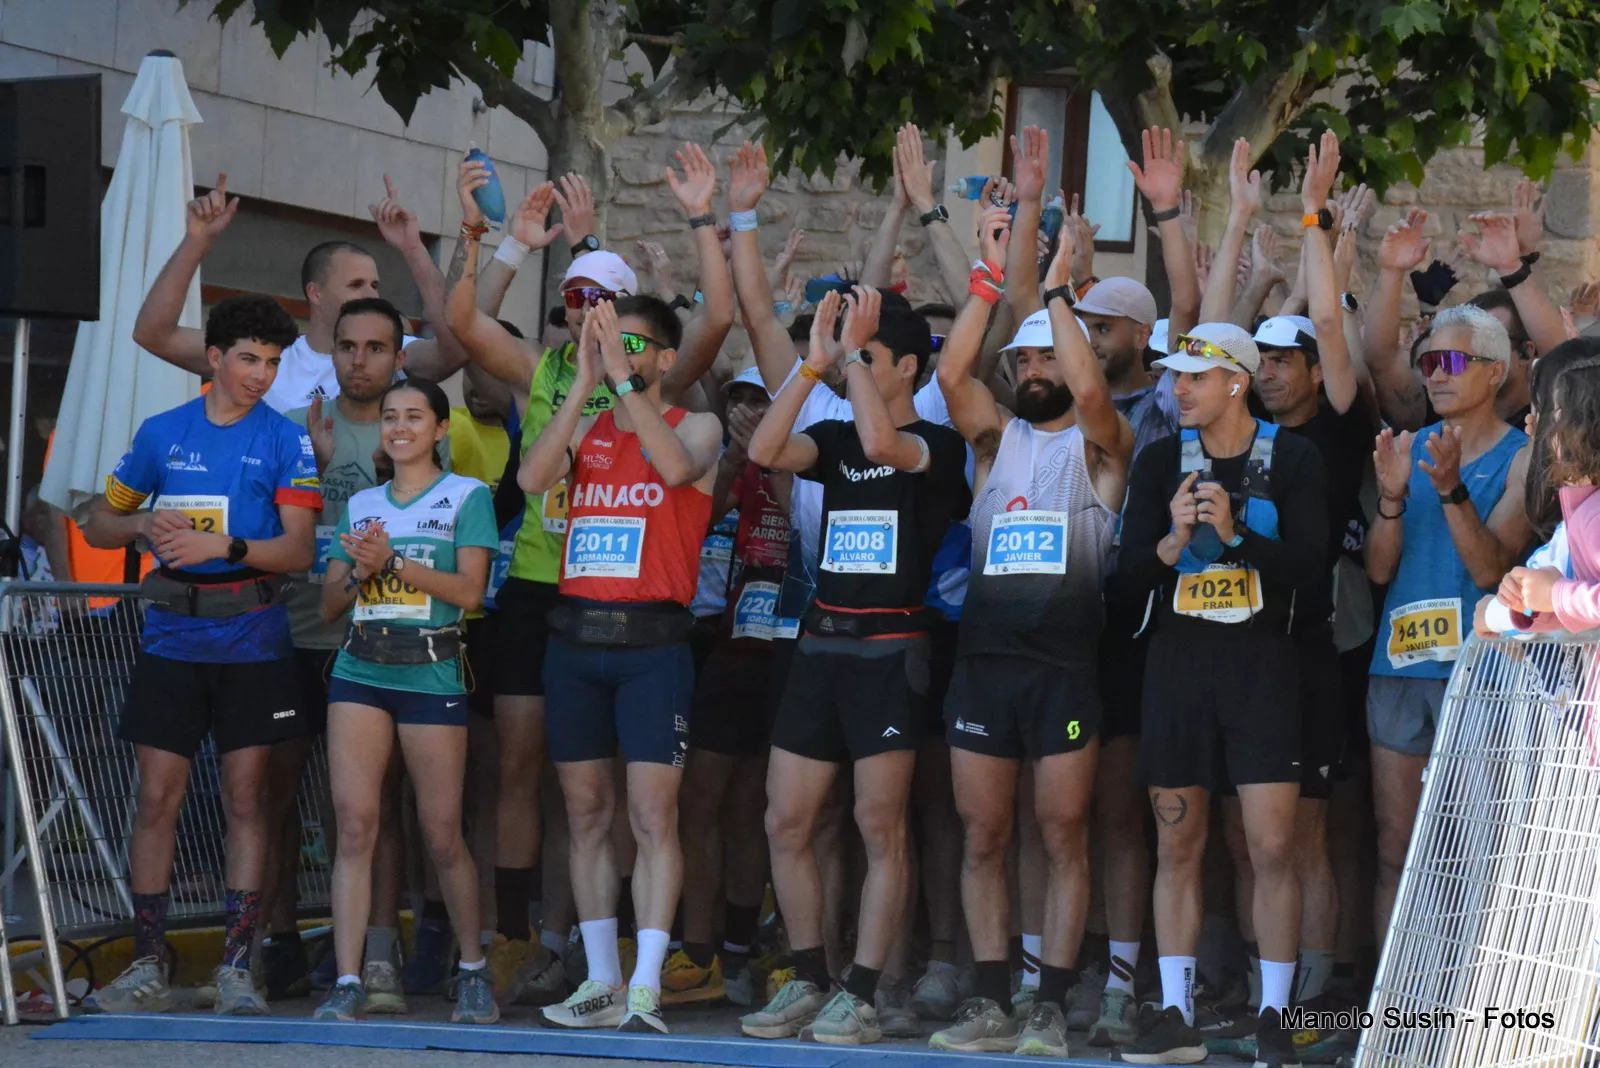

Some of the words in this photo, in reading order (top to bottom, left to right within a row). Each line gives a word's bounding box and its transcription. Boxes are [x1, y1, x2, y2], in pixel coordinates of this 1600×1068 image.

[552, 389, 610, 409] bse
[574, 533, 629, 552] 2011
[833, 531, 885, 551] 2008
[996, 531, 1054, 552] 2012
[576, 553, 625, 562] ARMANDO
[1004, 552, 1042, 562] JAVIER
[1188, 578, 1246, 599] 1021
[740, 596, 776, 615] 220
[1203, 601, 1233, 610] FRAN
[1399, 617, 1449, 642] 1410
[1405, 640, 1438, 652] JAVIER
[568, 992, 614, 1018] TERREX
